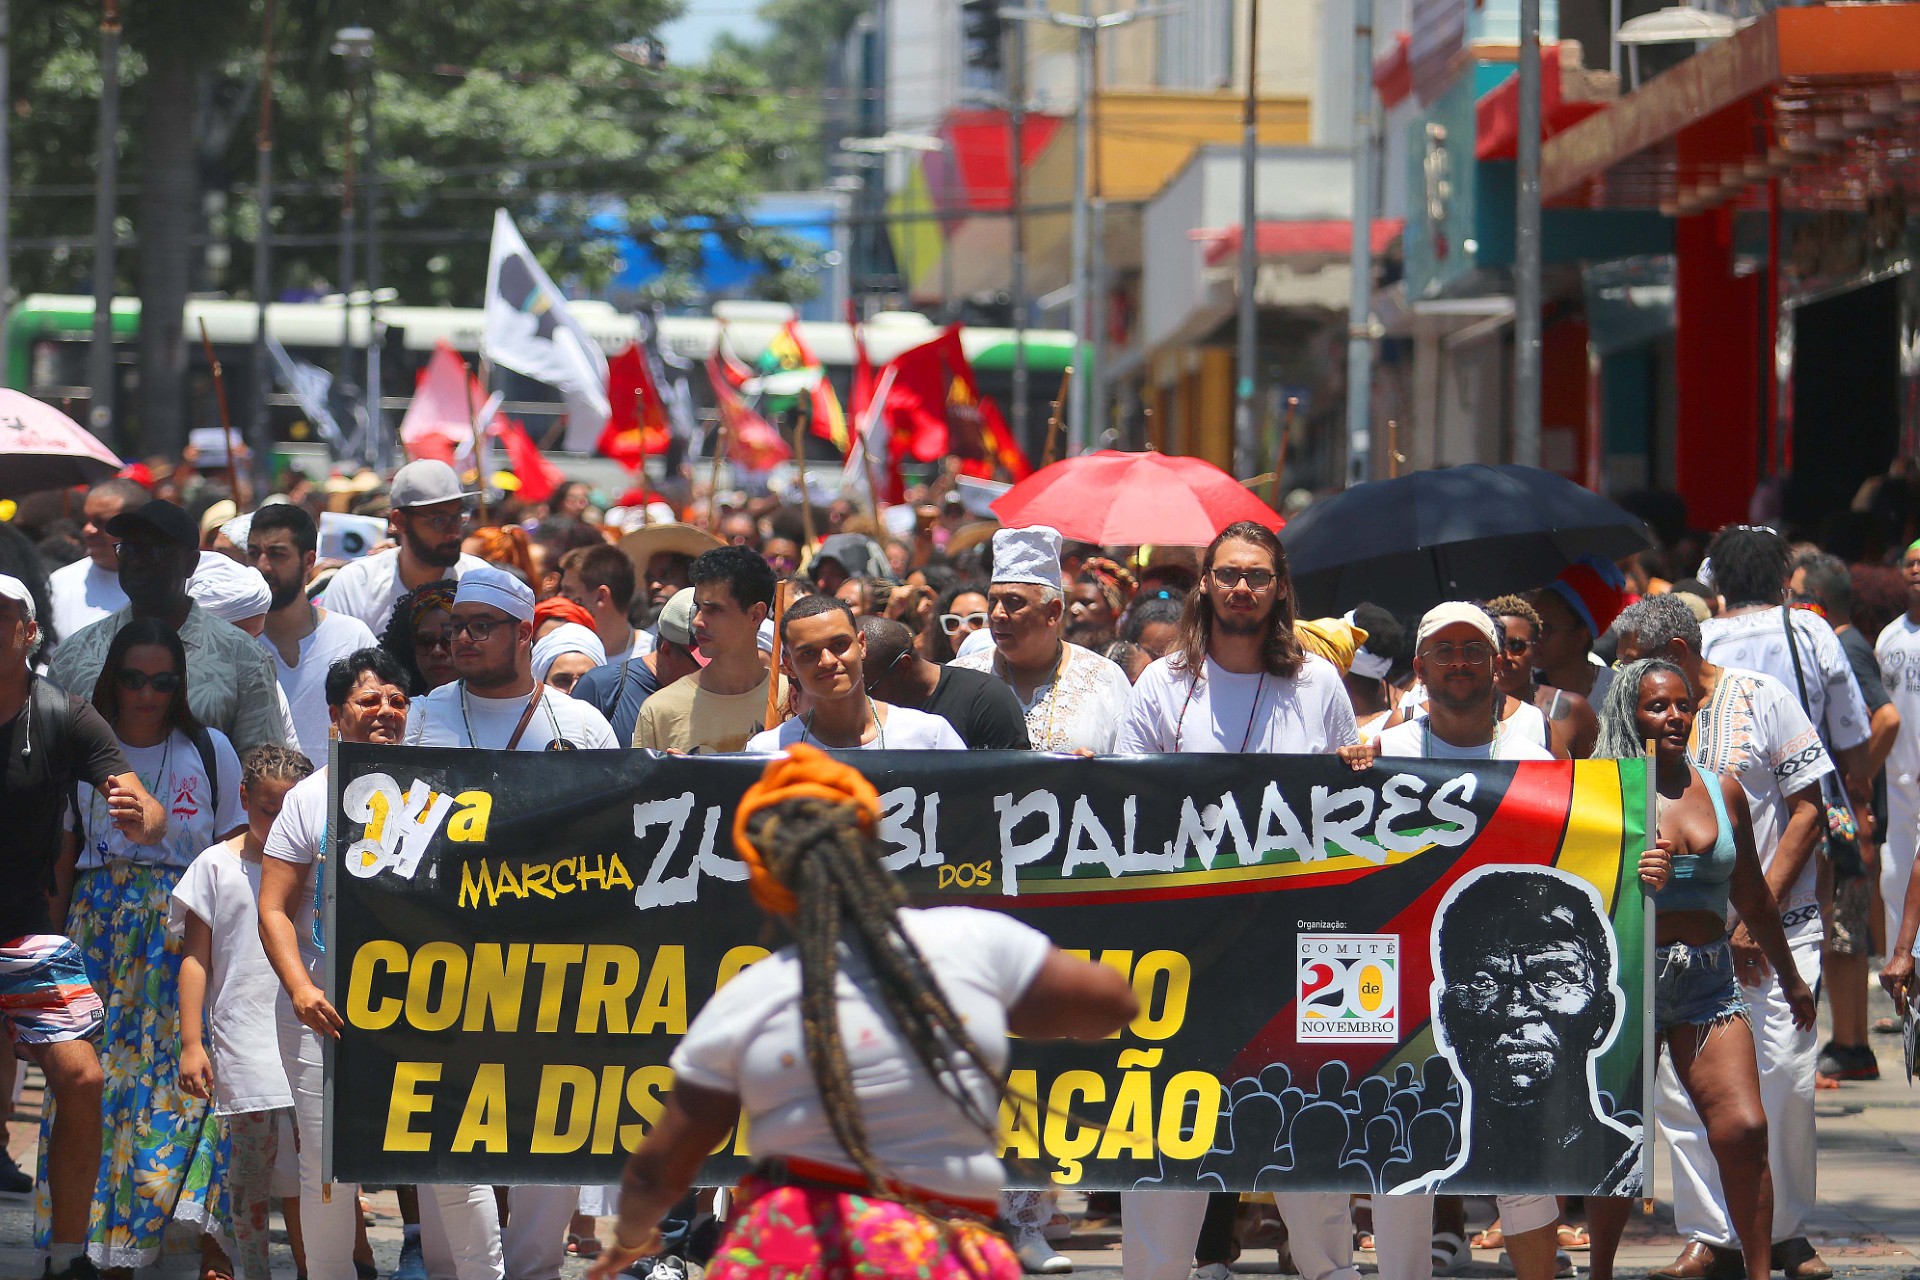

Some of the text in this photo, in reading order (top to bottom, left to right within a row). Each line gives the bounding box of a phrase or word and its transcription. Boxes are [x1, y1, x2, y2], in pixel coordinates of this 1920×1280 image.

[458, 853, 635, 909] MARCHA
[634, 787, 945, 910] ZUBI
[938, 861, 993, 890] DOS
[993, 772, 1478, 898] PALMARES
[1297, 920, 1347, 930] Organização:
[1301, 942, 1396, 954] COMITÊ
[346, 940, 688, 1035] CONTRA
[1361, 982, 1380, 994] de
[1301, 1021, 1394, 1033] NOVEMBRO
[383, 1062, 443, 1152] E
[451, 1063, 508, 1154] A
